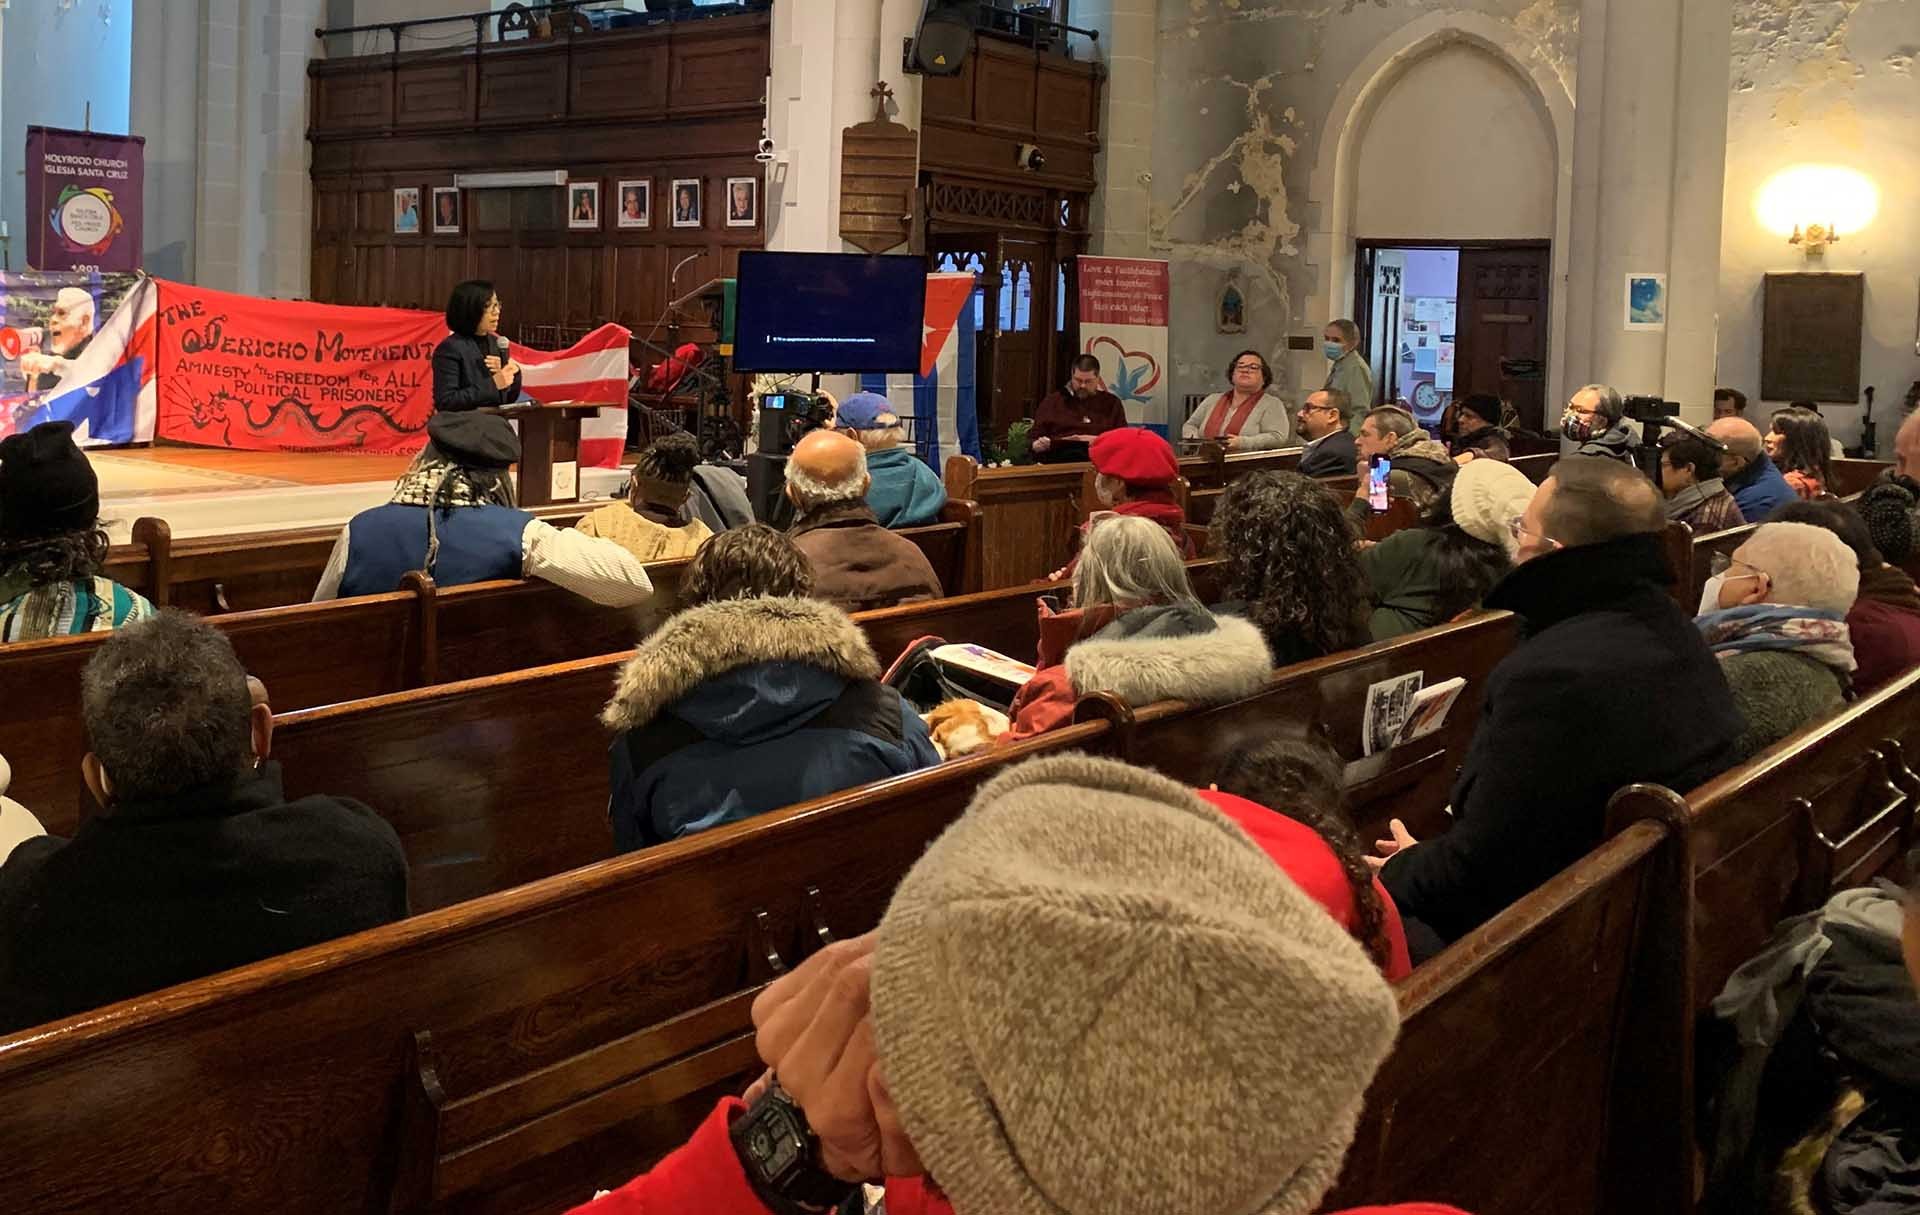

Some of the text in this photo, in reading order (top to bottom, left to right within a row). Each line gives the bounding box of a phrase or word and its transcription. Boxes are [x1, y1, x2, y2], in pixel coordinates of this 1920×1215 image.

[44, 153, 128, 168] HOLYROOD CHURCH
[45, 164, 129, 179] IGLESIA SANTA CRUZ
[1083, 263, 1102, 273] Love
[160, 300, 206, 326] THE
[1110, 302, 1129, 312] each
[314, 330, 434, 363] MOVEMENT
[175, 358, 251, 379] AMNESTY
[275, 370, 350, 387] FREEDOM
[358, 369, 378, 386] FOR
[384, 370, 422, 388] ALL
[234, 380, 408, 402] POLITICAL PRISONERS
